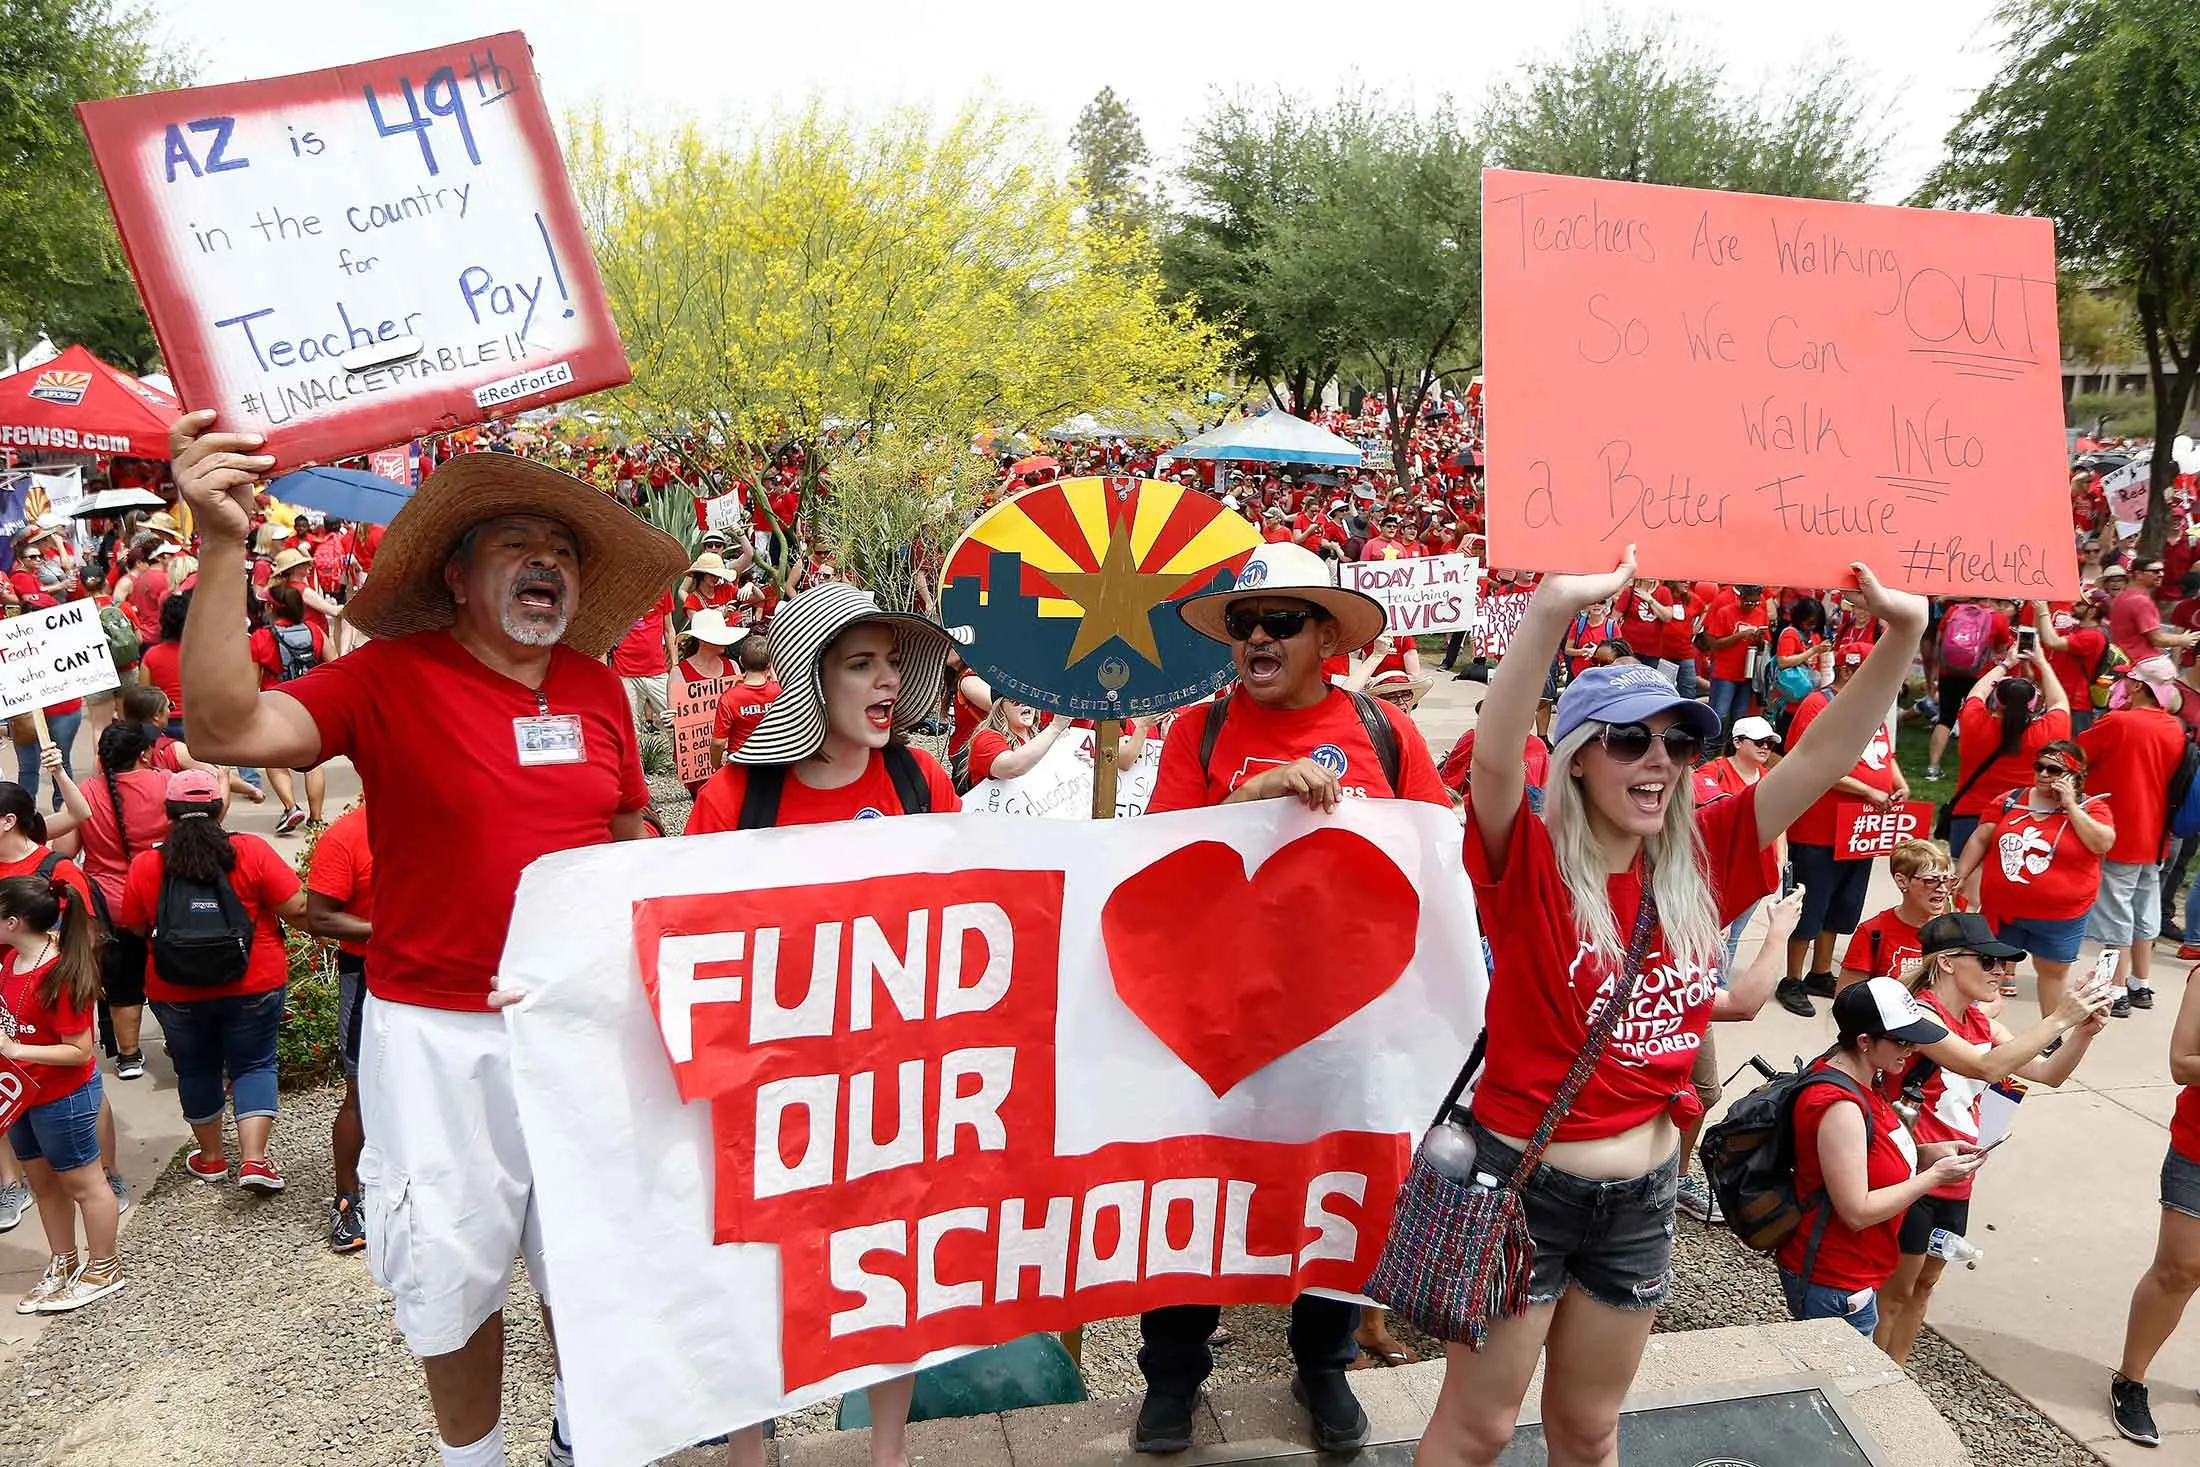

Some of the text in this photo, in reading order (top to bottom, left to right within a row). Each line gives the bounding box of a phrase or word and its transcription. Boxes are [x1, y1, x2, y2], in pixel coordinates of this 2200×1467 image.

[163, 48, 519, 183] AZ is 49th
[189, 182, 471, 254] in the country
[338, 248, 380, 277] for
[1493, 187, 2057, 354] Teachers Are Walking OUT
[214, 211, 576, 374] Teacher Pay!
[1578, 292, 1850, 374] So We Can
[240, 331, 528, 426] #UNACCEPTABLE!!
[478, 367, 568, 404] #RedForEd
[0, 425, 130, 453] FCW99.com
[1740, 395, 1984, 475] Walk INto
[1524, 438, 1898, 544] a Better Future
[1347, 563, 1416, 593] TODAY,
[1898, 537, 2054, 588] #Red4Ed
[1381, 588, 1450, 606] teaching
[1388, 596, 1462, 632] IVICS
[1477, 602, 1526, 617] EDUCATO
[6, 607, 83, 640] who CAN
[19, 643, 104, 685] who CAN'T
[2, 691, 33, 707] laws
[1853, 813, 1917, 834] #RED
[658, 900, 1015, 1064] FUND
[753, 1046, 1017, 1200] OUR
[828, 1171, 1368, 1341] SCHOOLS
